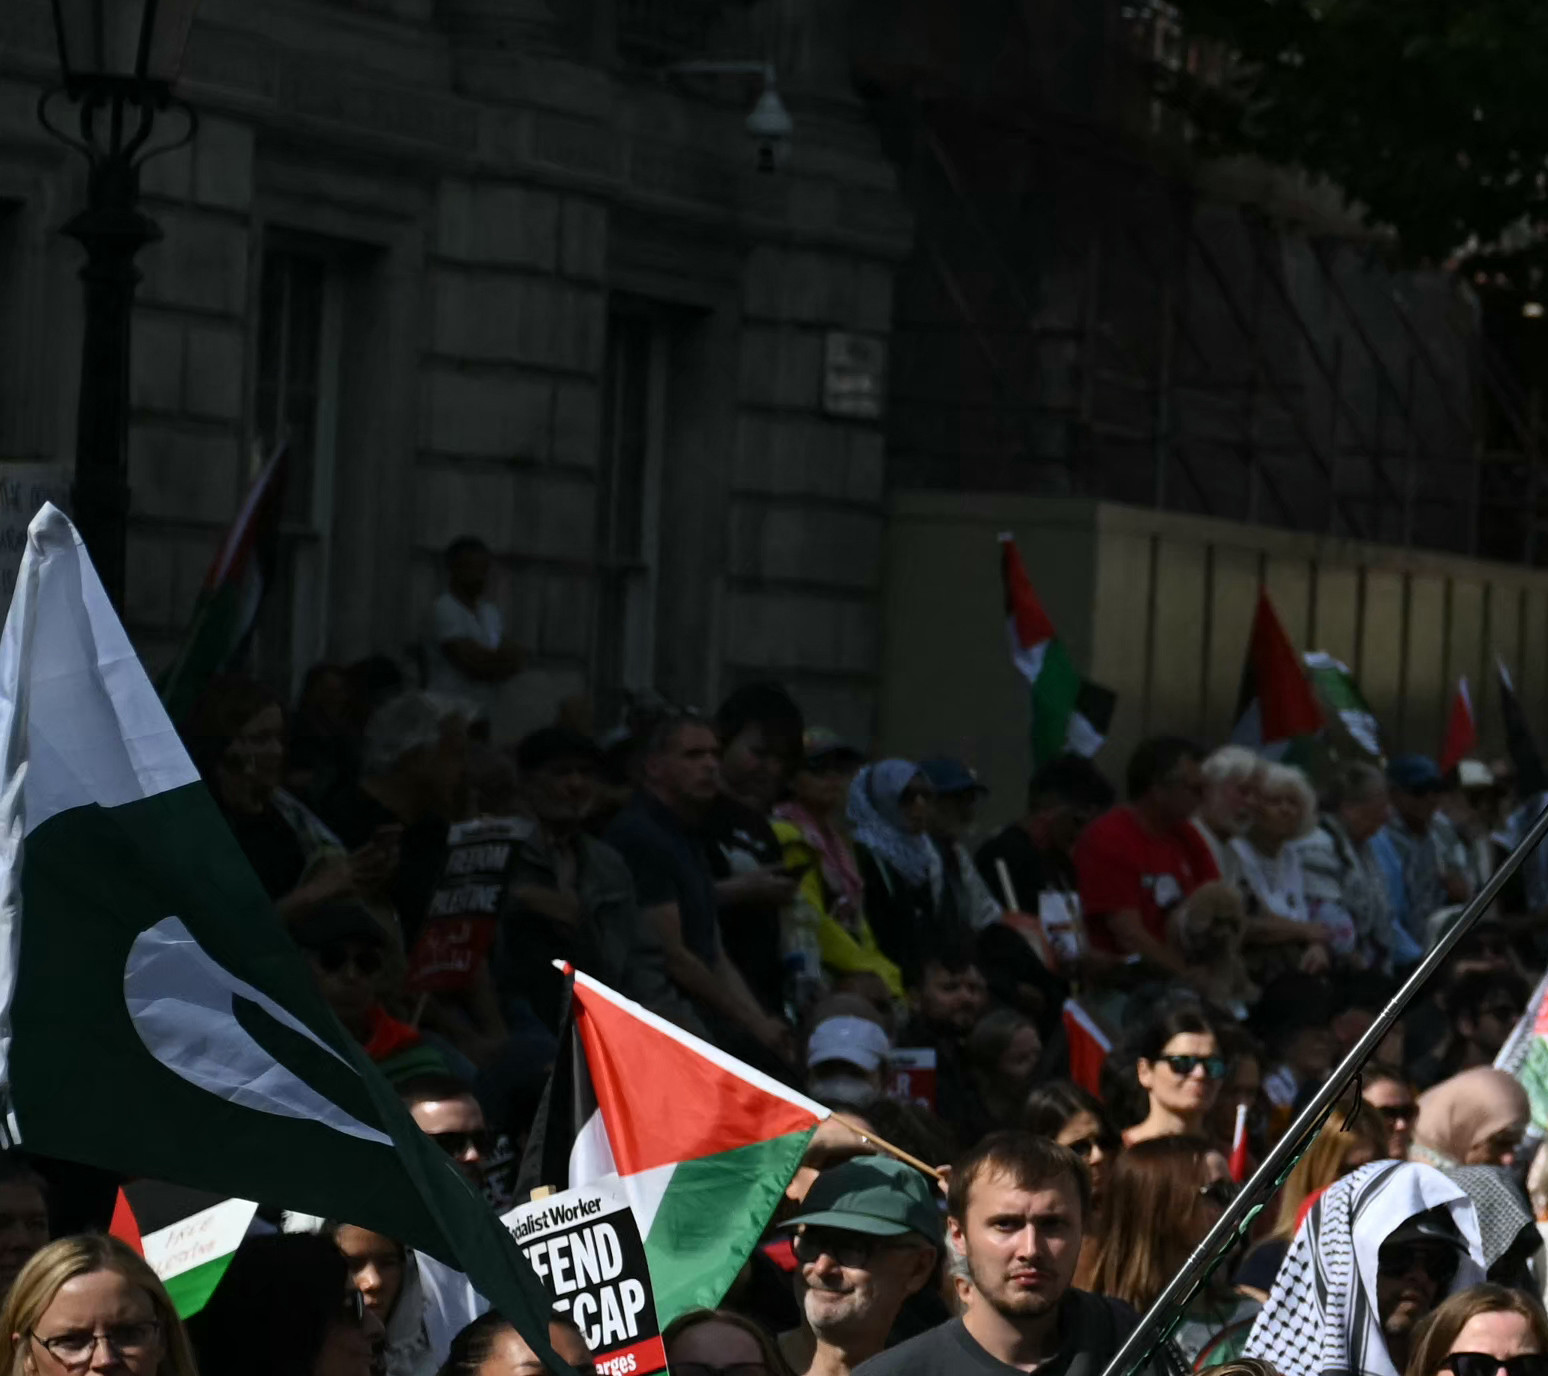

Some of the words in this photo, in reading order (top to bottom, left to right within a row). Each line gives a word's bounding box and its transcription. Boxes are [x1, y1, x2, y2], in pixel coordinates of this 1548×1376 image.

[506, 1208, 550, 1242] ocialist
[548, 1196, 602, 1228] Worker
[523, 1222, 623, 1296] FEND
